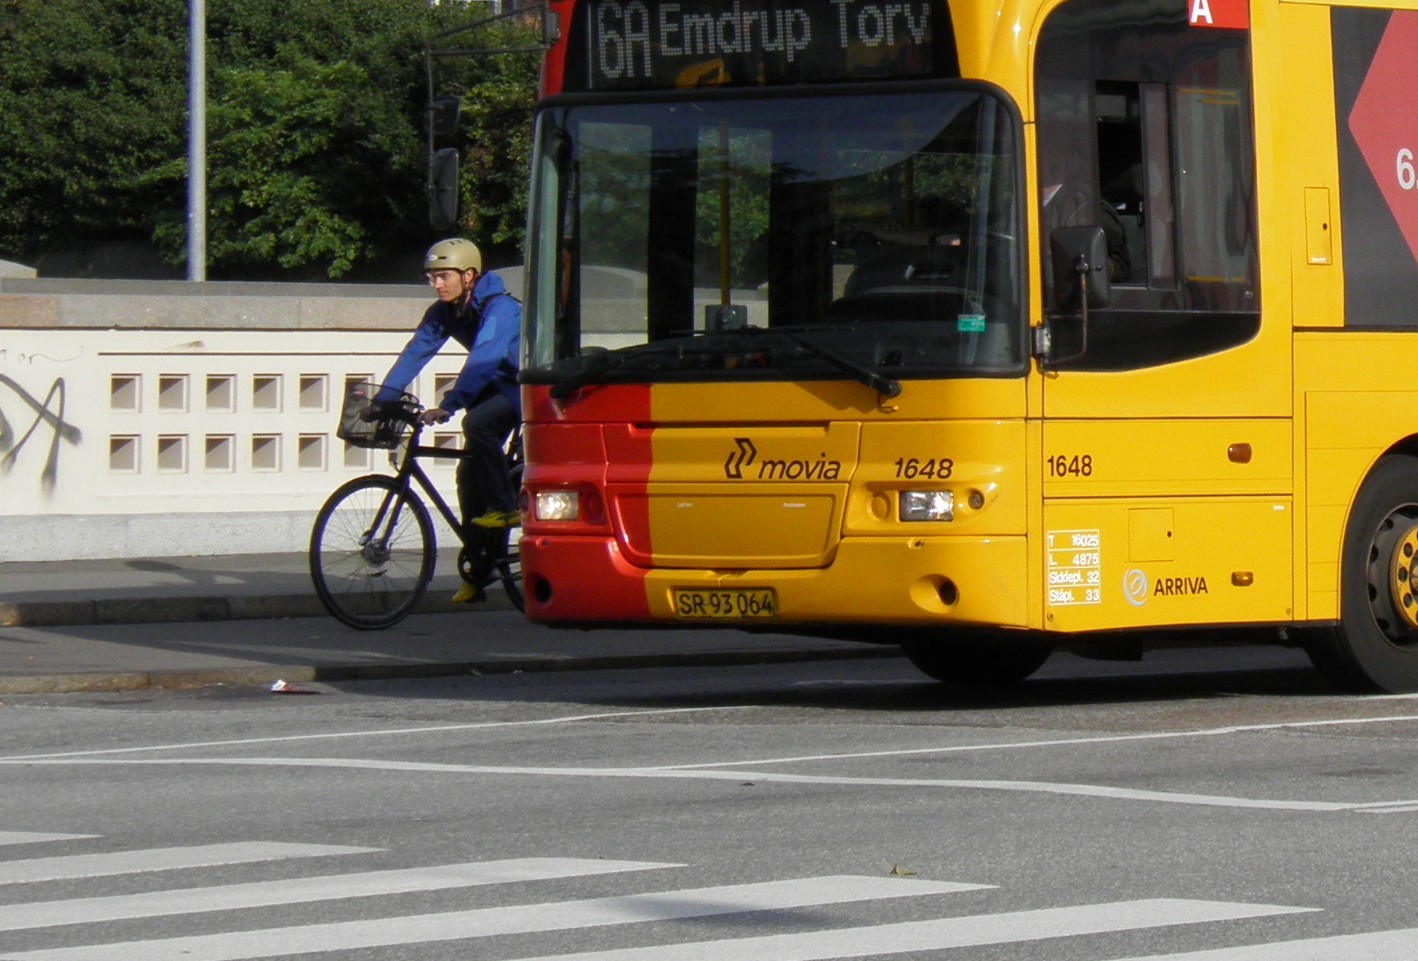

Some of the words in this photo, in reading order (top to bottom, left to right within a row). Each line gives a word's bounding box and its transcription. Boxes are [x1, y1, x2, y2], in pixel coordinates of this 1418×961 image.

[659, 0, 811, 62] Emdrup
[758, 452, 842, 480] movia
[893, 458, 954, 480] 1648
[1047, 454, 1093, 477] 1648
[1048, 535, 1055, 547] T
[1071, 534, 1099, 547] 16025
[1049, 553, 1057, 566] L
[1073, 552, 1099, 566] 4875
[1049, 570, 1083, 585] Siddepl.
[1087, 570, 1099, 584] 32
[1153, 577, 1209, 597] ARRIVA
[679, 593, 707, 615] SR
[709, 593, 733, 614] 93
[737, 593, 773, 615] 064
[1086, 588, 1099, 601] 33
